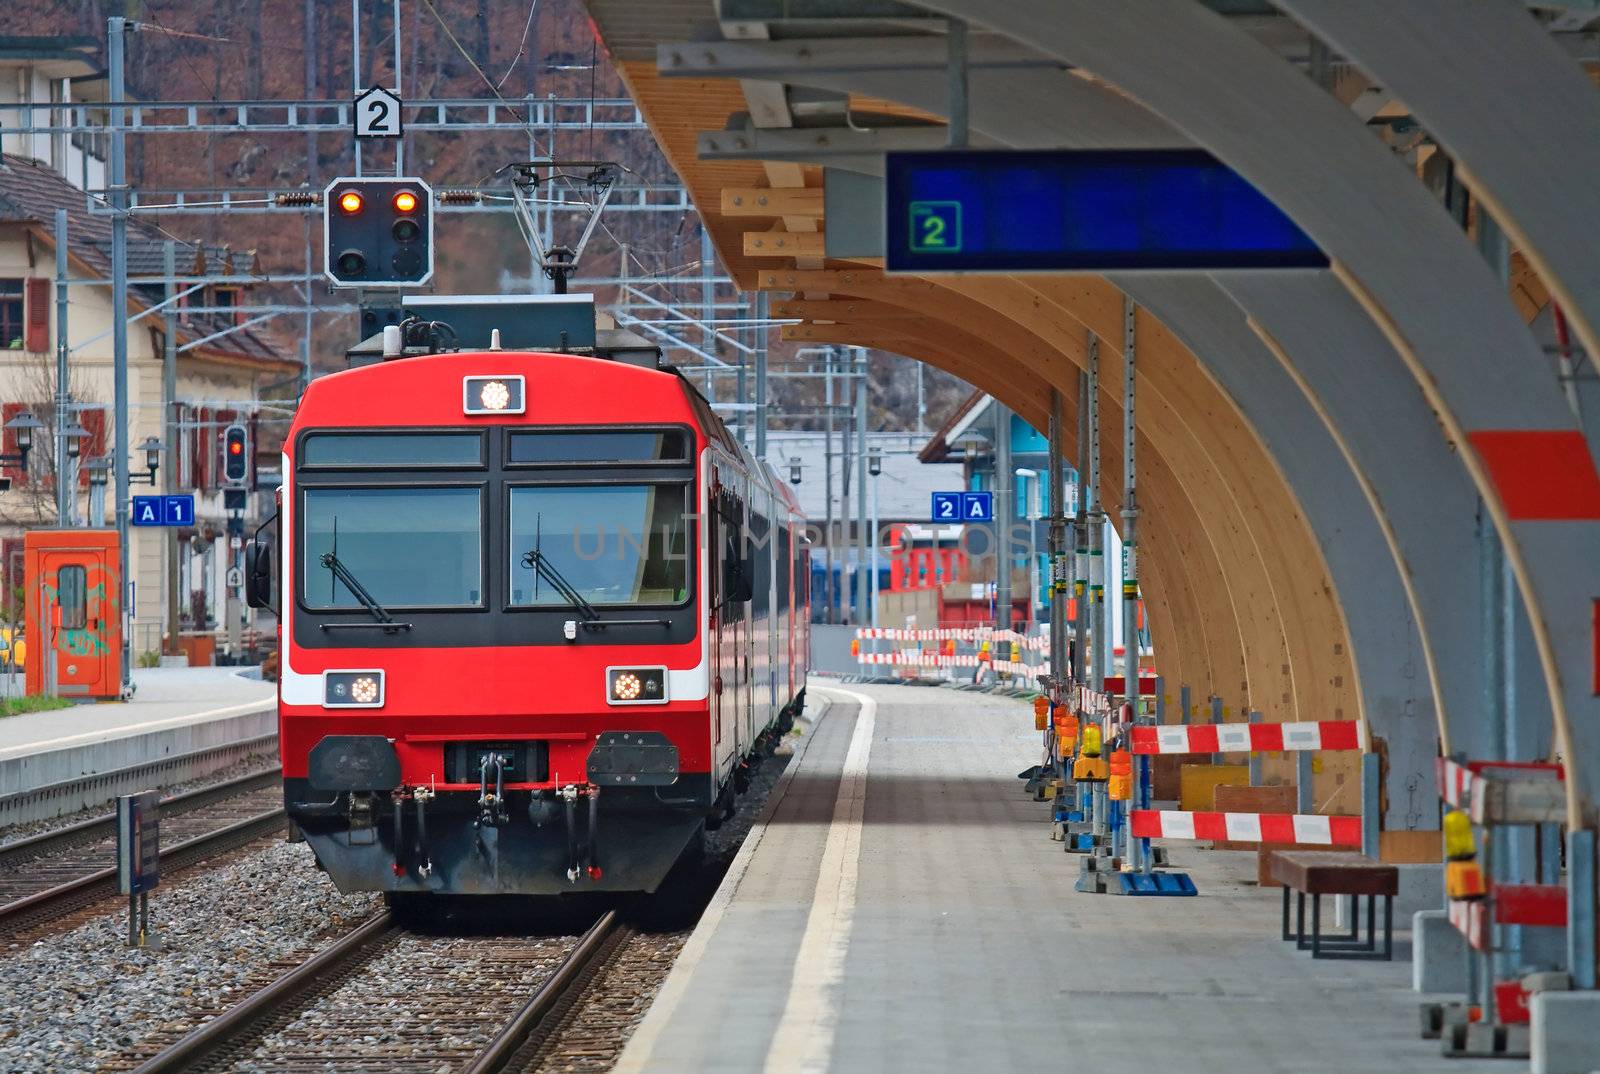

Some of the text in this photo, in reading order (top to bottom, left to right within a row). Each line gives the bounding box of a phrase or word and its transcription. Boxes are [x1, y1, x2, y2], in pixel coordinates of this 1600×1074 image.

[367, 100, 389, 131] 2
[924, 216, 945, 244] 2
[142, 505, 182, 520] A 1
[941, 501, 984, 517] 2 A
[231, 572, 238, 584] 4
